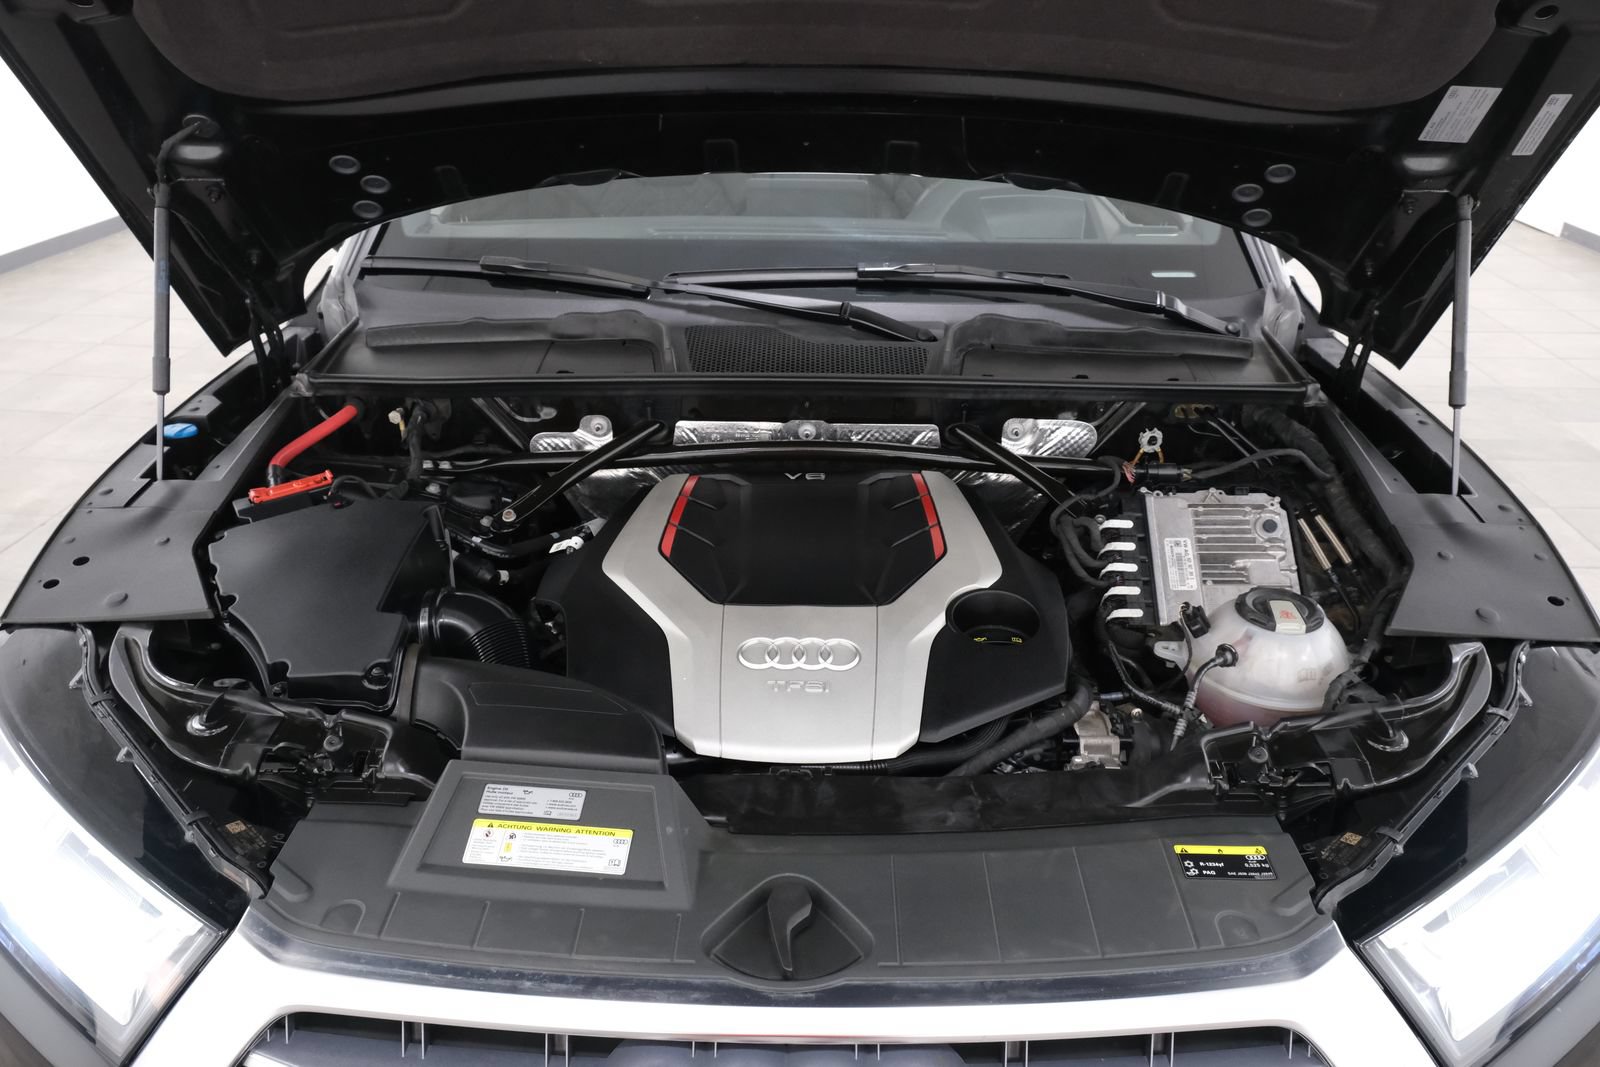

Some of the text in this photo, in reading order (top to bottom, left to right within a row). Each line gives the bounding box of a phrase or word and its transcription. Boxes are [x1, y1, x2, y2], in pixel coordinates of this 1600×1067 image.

[783, 472, 826, 481] V6
[498, 823, 616, 837] ACHTUNG WARNING ATTENTION
